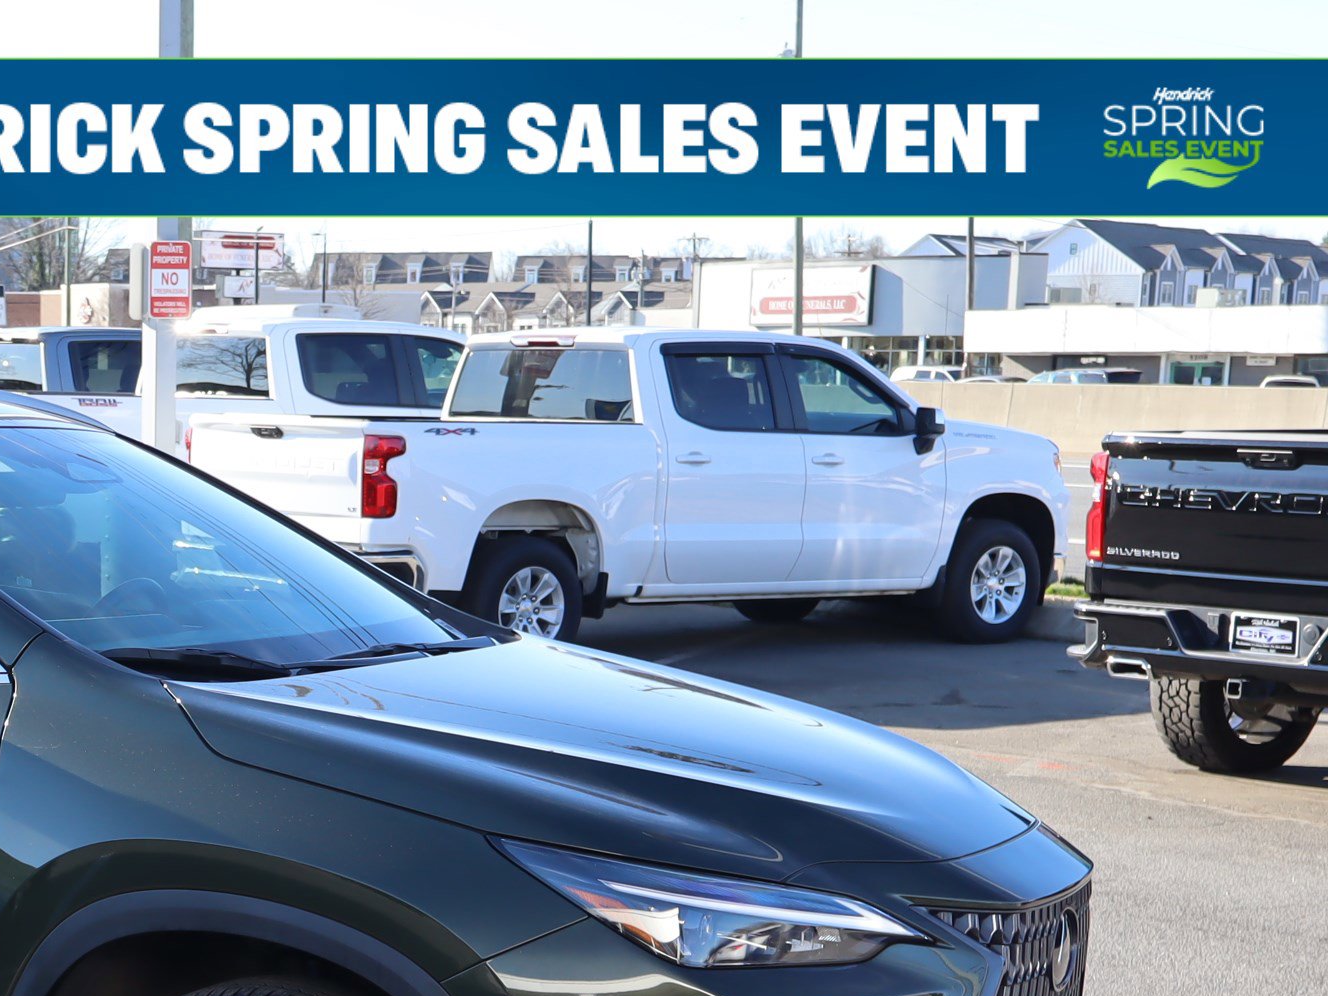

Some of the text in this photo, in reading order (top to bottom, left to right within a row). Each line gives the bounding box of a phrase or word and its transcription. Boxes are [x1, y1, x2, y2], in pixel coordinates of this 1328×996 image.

[156, 245, 184, 254] PRIVATE
[153, 255, 188, 264] PROPERTY
[161, 272, 179, 286] NO
[1118, 484, 1328, 515] CHEVRO
[1106, 546, 1180, 560] SILVERADO
